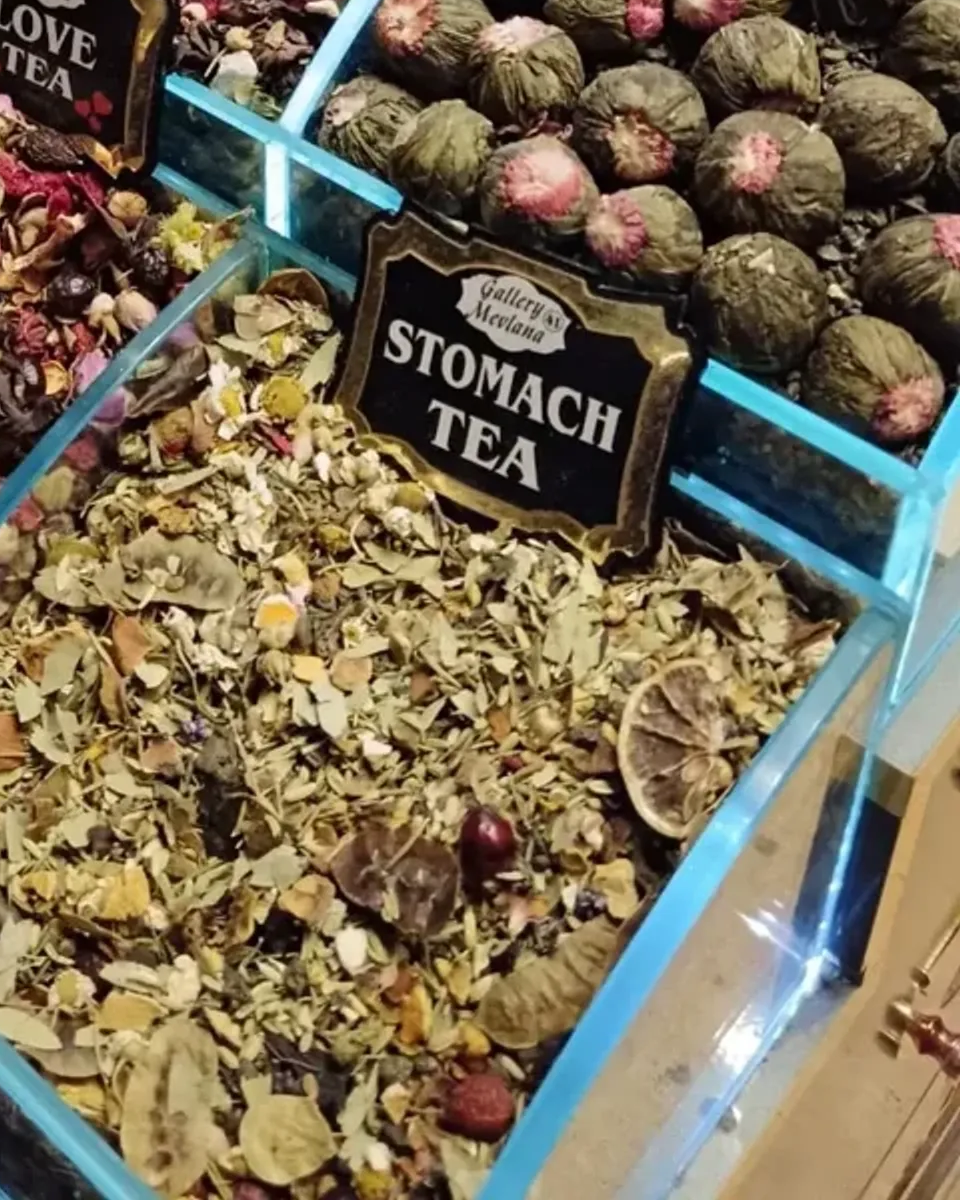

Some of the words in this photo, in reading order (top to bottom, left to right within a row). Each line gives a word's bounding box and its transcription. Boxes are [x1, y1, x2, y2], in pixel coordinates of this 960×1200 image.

[2, 42, 74, 101] TEA
[463, 300, 545, 344] Mevlana
[480, 279, 545, 320] Gallery
[383, 319, 622, 453] STOMACH
[428, 399, 540, 492] TEA
